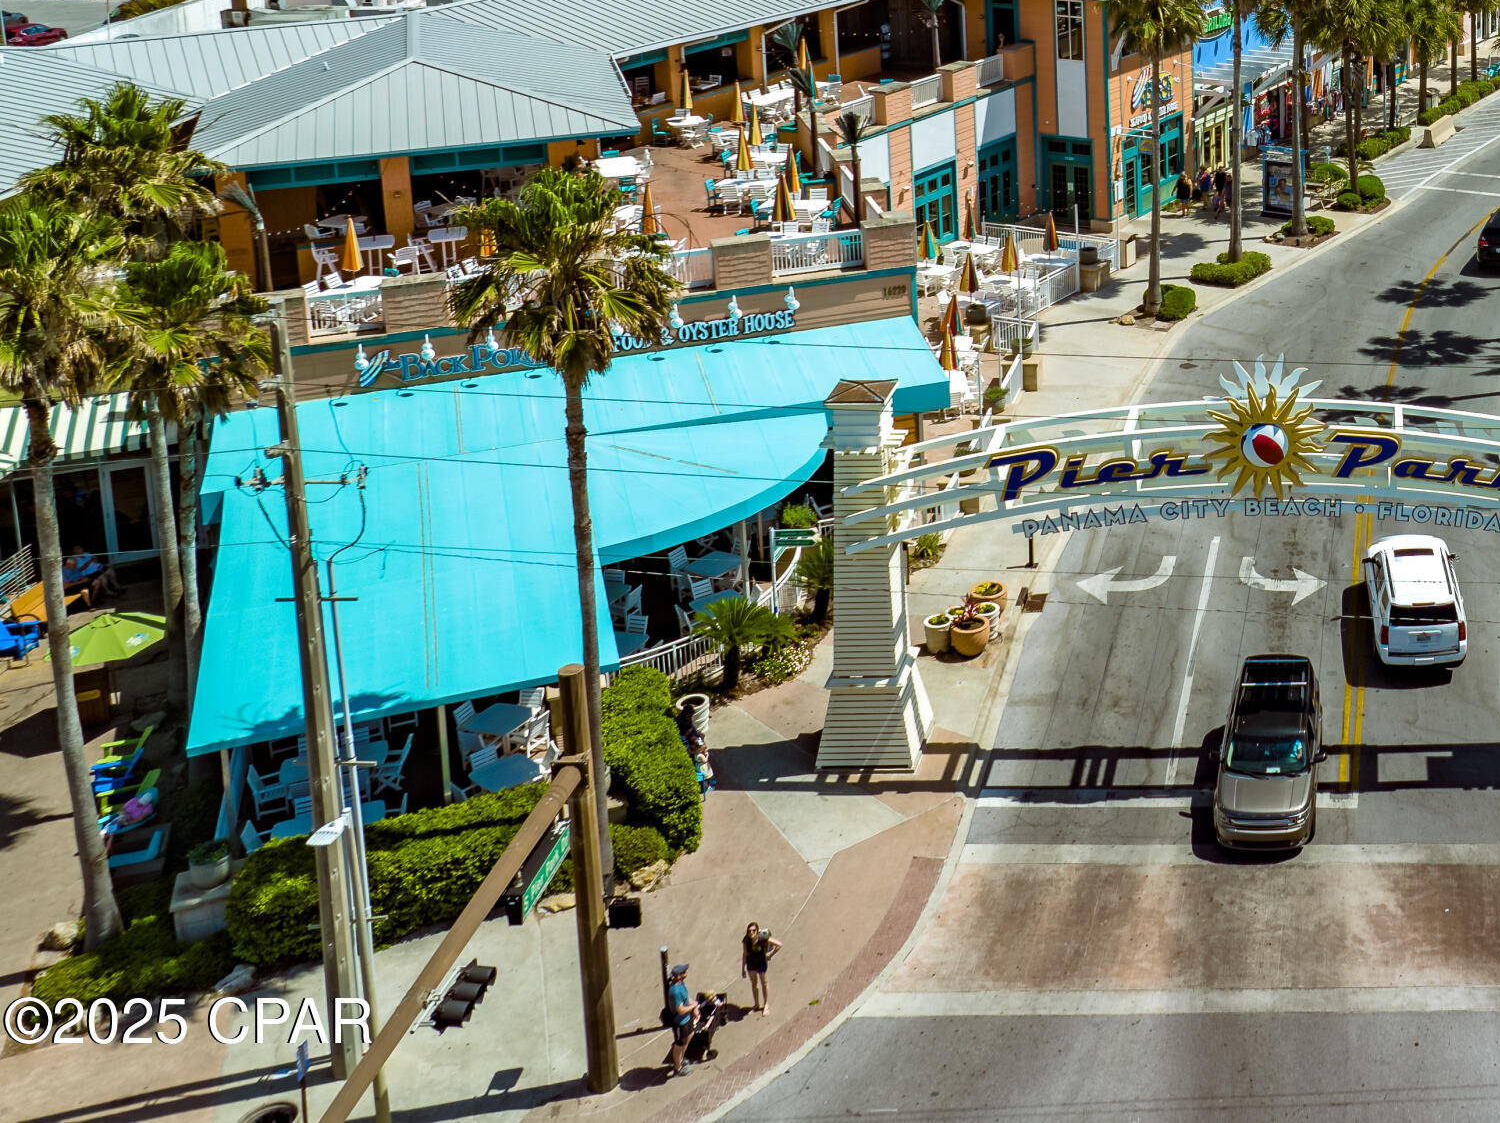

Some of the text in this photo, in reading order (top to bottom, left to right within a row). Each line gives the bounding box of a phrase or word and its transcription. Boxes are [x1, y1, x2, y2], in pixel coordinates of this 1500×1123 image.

[678, 317, 740, 343] OYSTER
[742, 309, 796, 335] HOUSE
[984, 445, 1213, 503] Pier
[1022, 503, 1148, 539] PANAMA
[1160, 498, 1231, 520] CITY
[1244, 496, 1342, 517] BEACH
